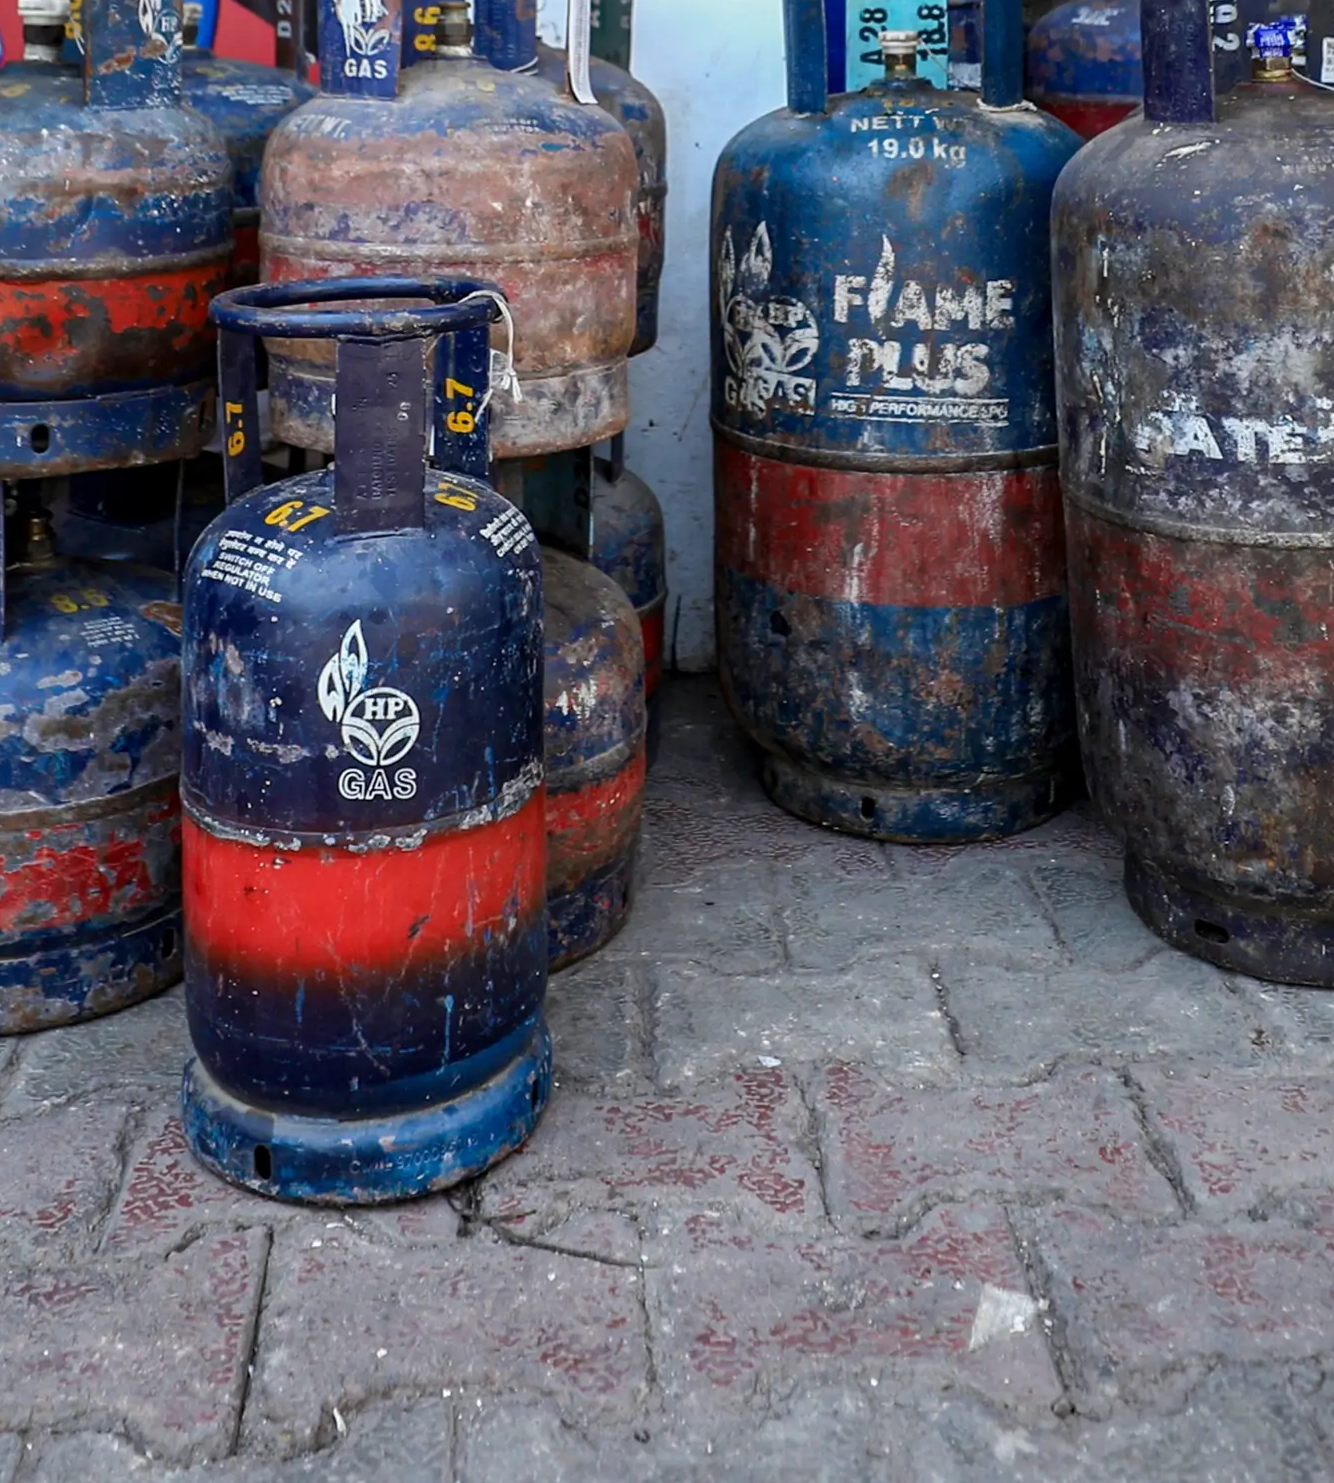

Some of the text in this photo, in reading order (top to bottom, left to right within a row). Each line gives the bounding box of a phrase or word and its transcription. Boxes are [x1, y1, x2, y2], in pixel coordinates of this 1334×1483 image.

[344, 57, 388, 80] GAS
[868, 138, 967, 168] 19.0 kg
[846, 337, 992, 396] PLUS
[445, 377, 476, 434] 6.7
[869, 400, 979, 419] PERFORMANCE
[225, 401, 245, 457] 6.7
[264, 500, 331, 533] 6.7
[212, 559, 271, 587] REGULATOR
[218, 551, 276, 576] SWITCH OFF
[201, 568, 283, 604] WHEN NOT IN USE
[364, 698, 405, 721] HP
[337, 768, 418, 801] GAS
